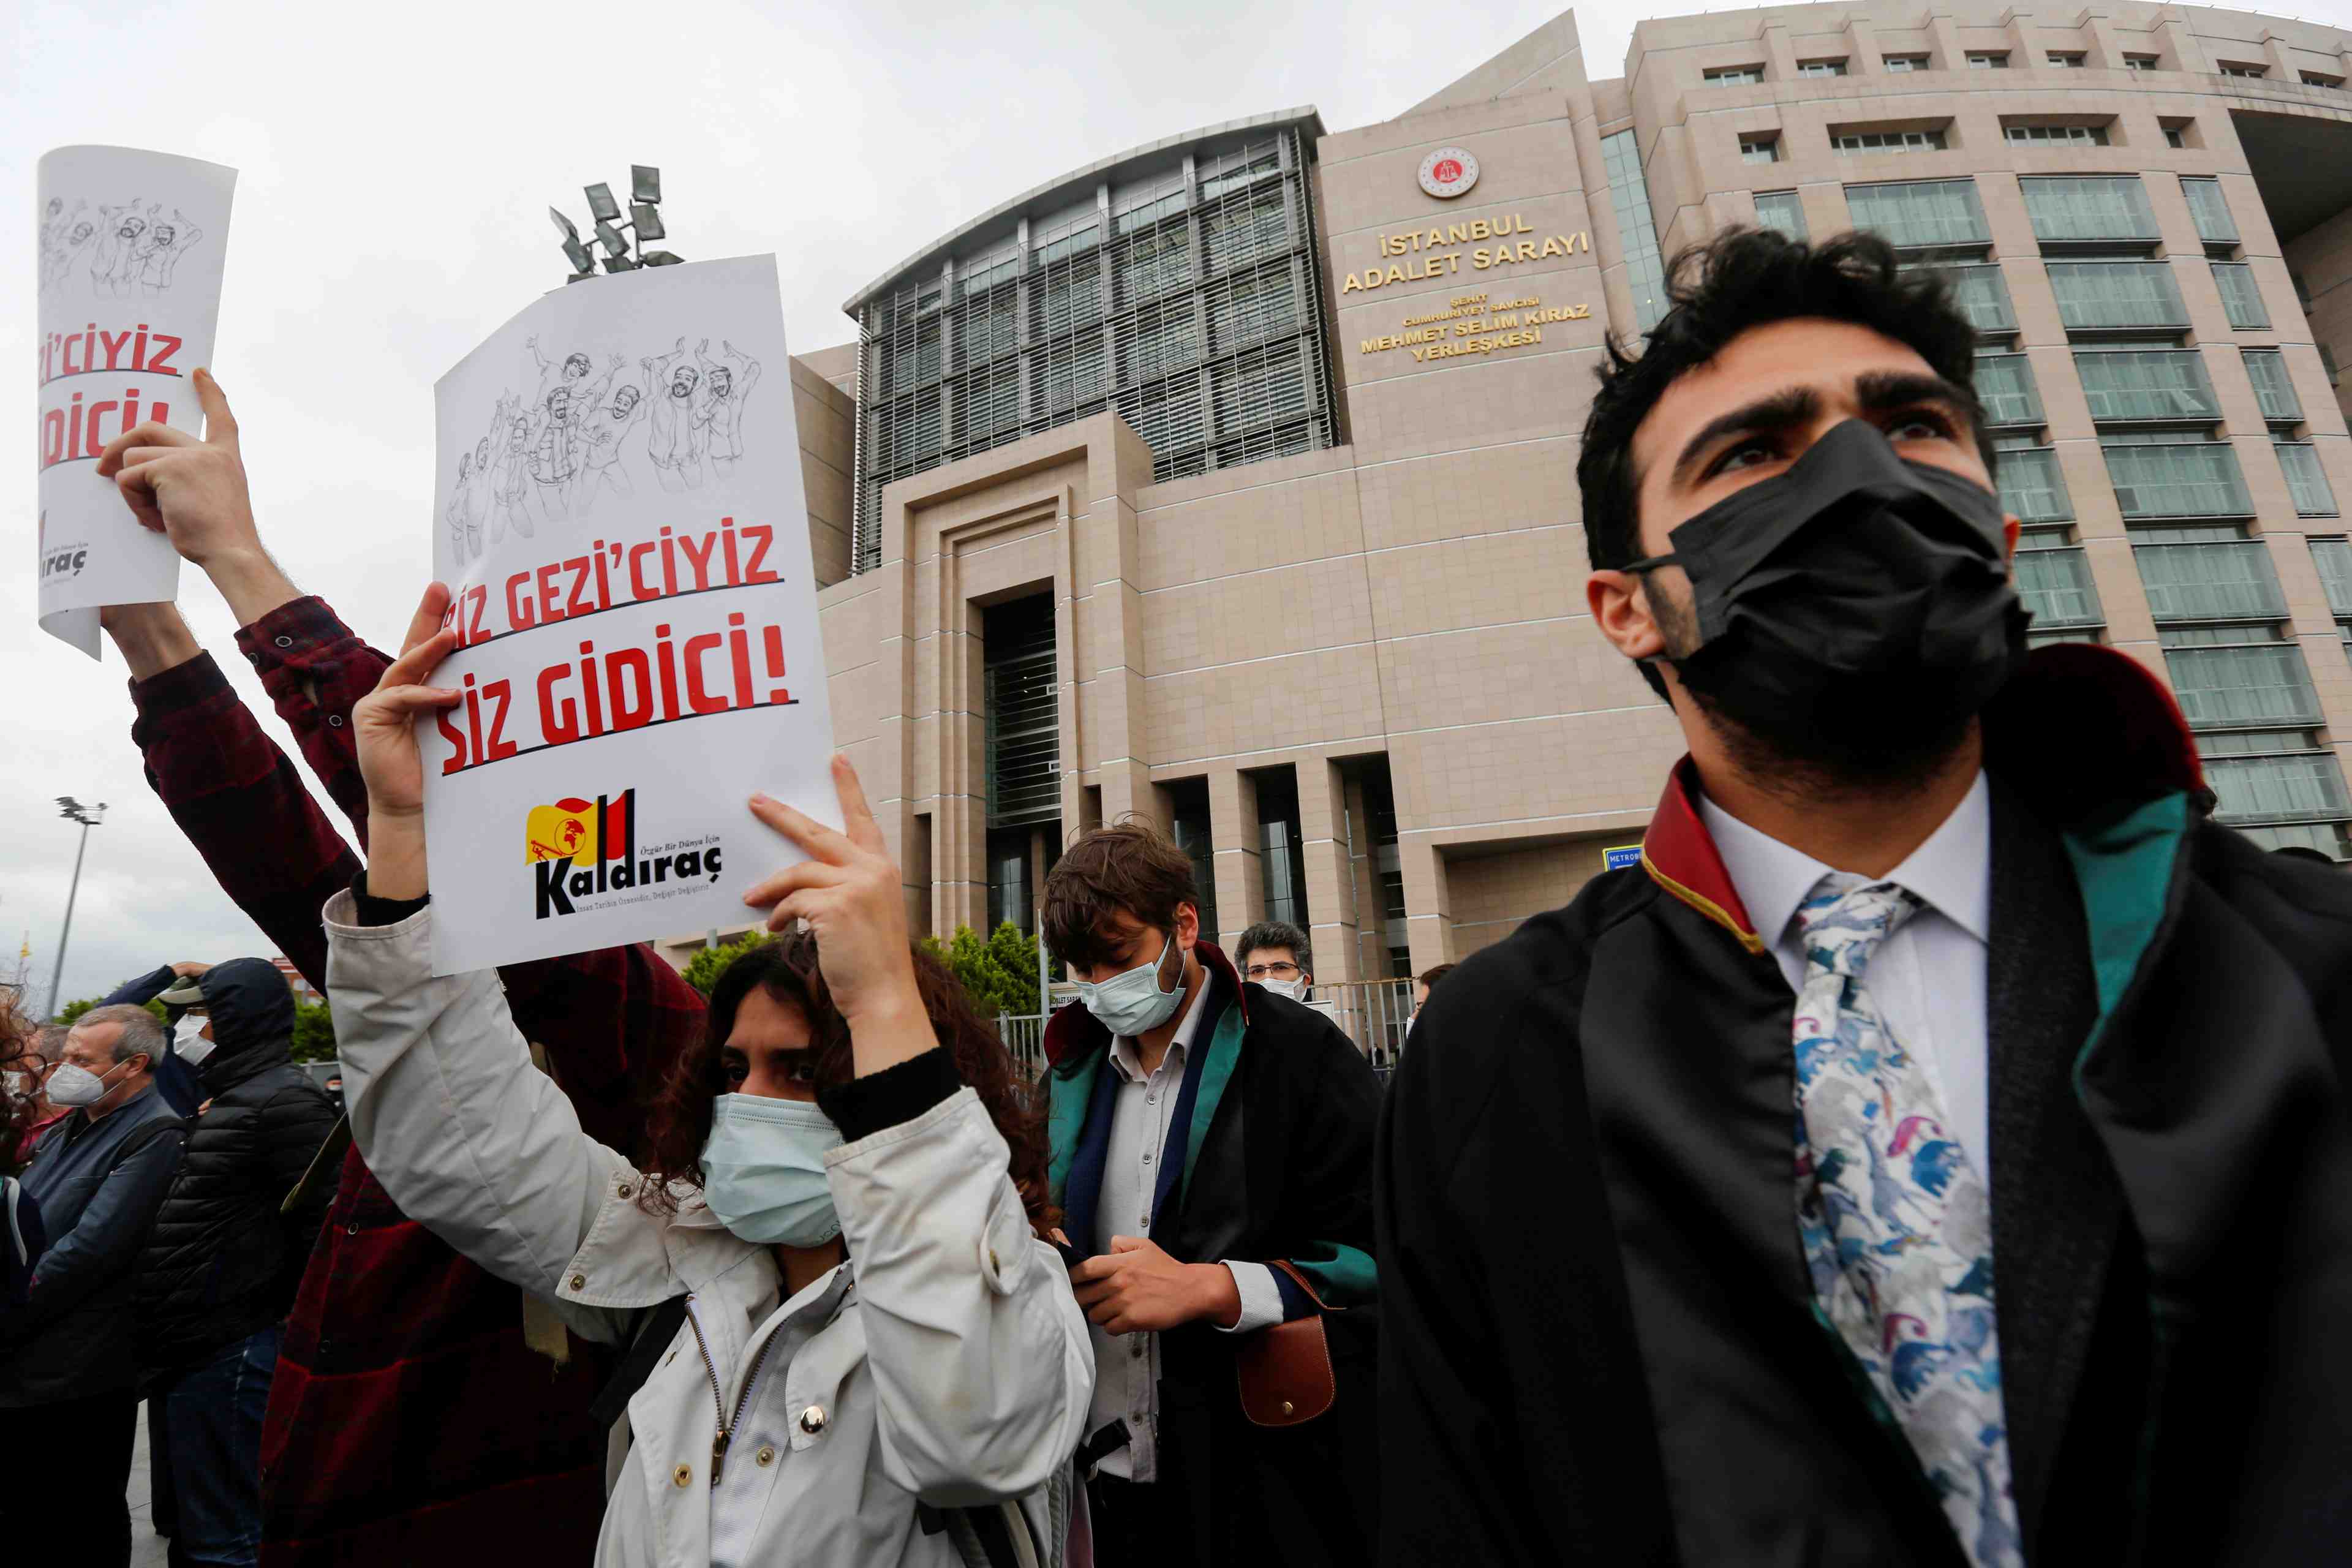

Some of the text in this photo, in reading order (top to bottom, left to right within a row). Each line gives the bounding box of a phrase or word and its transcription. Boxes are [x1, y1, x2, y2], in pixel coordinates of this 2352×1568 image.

[1378, 214, 1534, 257] İSTANBUL
[1343, 232, 1589, 294] ADALET SARAYI
[1361, 304, 1591, 353] MEHMET SELİM KİRAZ
[1411, 326, 1543, 363] YERLEŞKESİ
[436, 612, 790, 775] SİZ GİDİCİ!
[535, 788, 722, 920] Kaldıraç
[640, 834, 720, 856] Özgür Bir Dünya İçin
[1610, 853, 1642, 863] METROB
